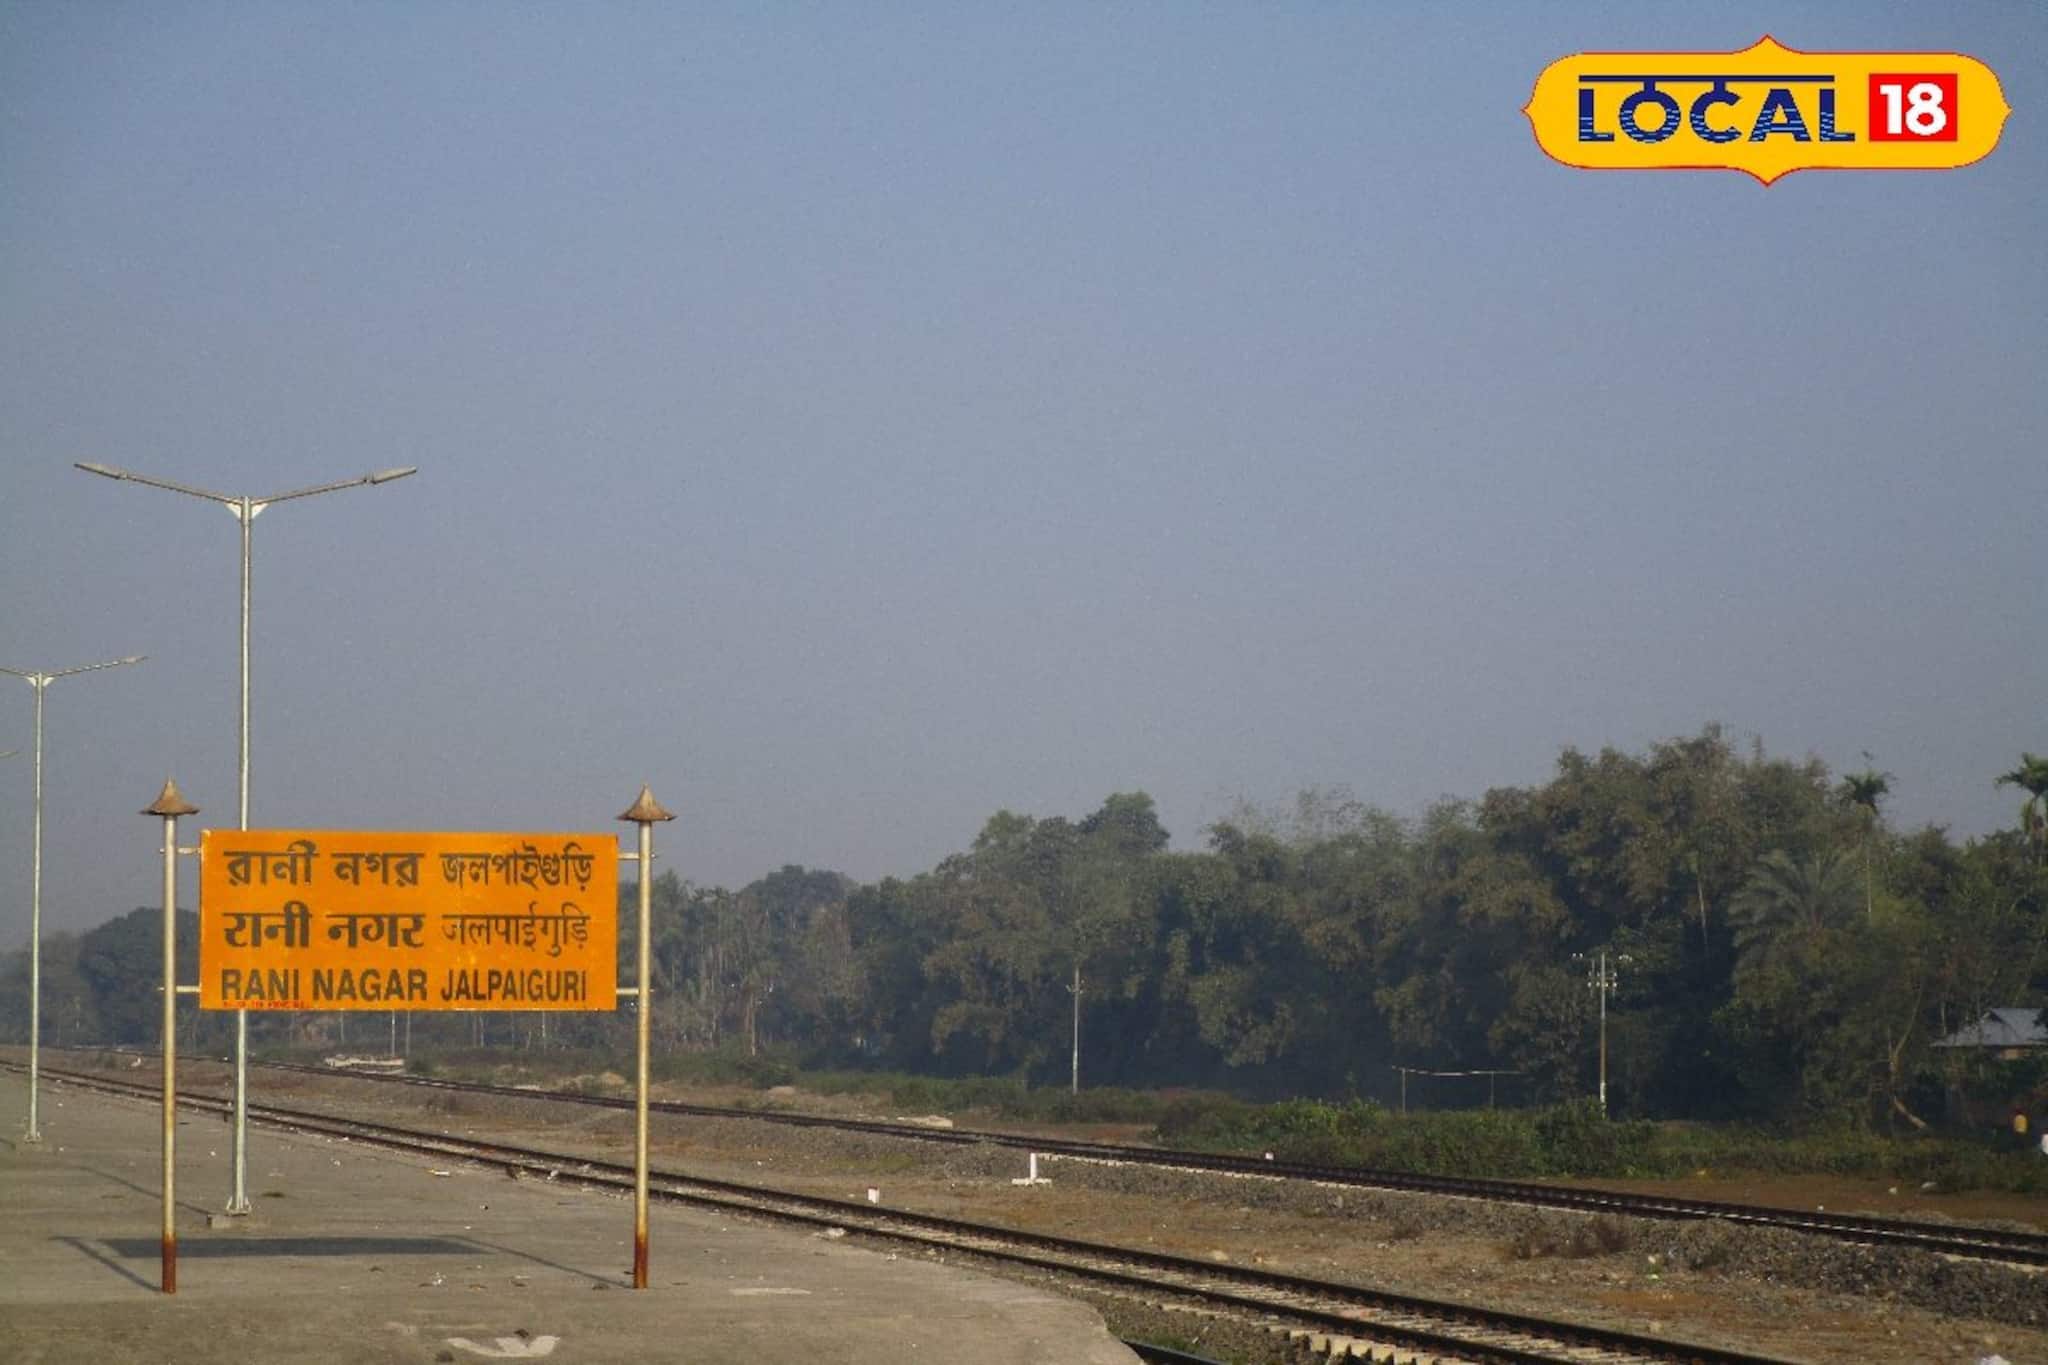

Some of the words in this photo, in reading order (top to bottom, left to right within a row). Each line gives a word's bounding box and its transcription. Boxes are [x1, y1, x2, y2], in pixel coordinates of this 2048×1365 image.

[223, 840, 320, 886] রানী
[331, 852, 425, 887] নগর
[440, 840, 595, 892] জলপাইগুড়ি
[222, 900, 313, 948] रानी
[326, 912, 426, 949] नगर
[441, 901, 591, 957] जलपाईगुड़ि
[221, 968, 300, 1001] RANI
[312, 968, 428, 1002] NAGAR
[441, 968, 587, 1002] JALPAIGURI
